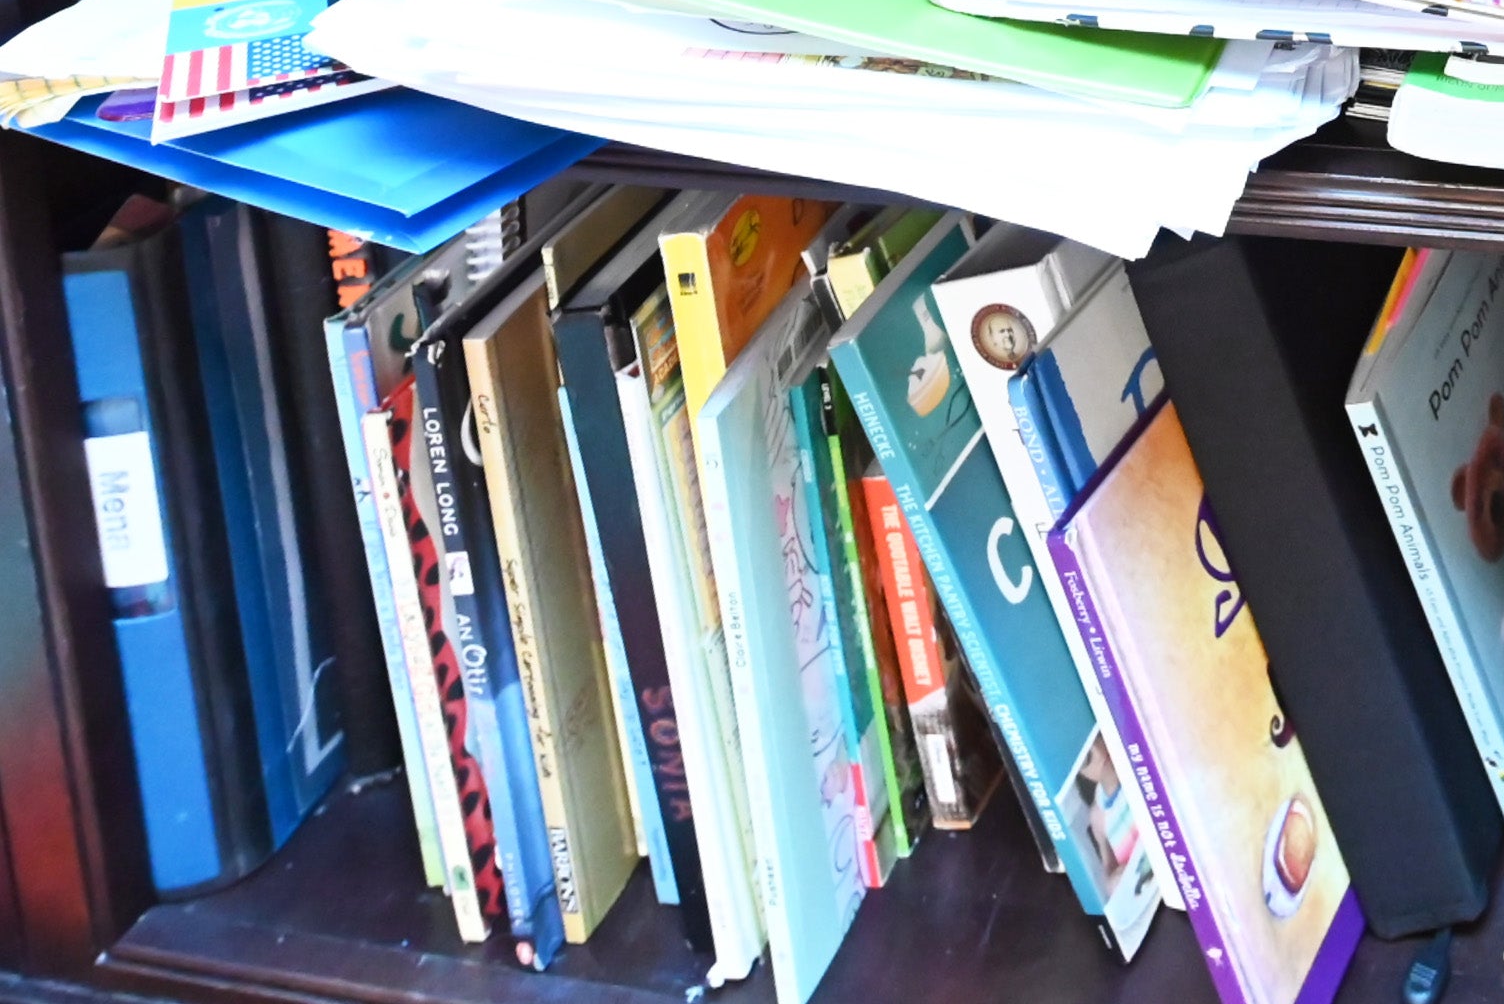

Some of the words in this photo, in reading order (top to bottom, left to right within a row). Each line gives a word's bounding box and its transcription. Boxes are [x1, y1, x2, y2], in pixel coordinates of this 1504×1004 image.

[1428, 360, 1464, 421] Pom
[1459, 305, 1491, 358] Pom
[853, 390, 895, 462] HEINECKE
[1011, 404, 1046, 464] BOND
[422, 406, 448, 475] LOREN
[436, 482, 459, 537] LONG
[97, 470, 131, 552] Mena
[879, 503, 902, 530] THE
[1371, 446, 1391, 490] Pom
[1386, 483, 1407, 518] Pom
[1400, 523, 1430, 581] Animals
[884, 531, 915, 600] QUOTABLE
[1057, 568, 1097, 627] Fosberry
[455, 613, 473, 640] AN
[898, 599, 924, 637] WALT
[460, 643, 488, 696] Otis
[895, 483, 918, 513] THE
[908, 512, 945, 574] KITCHEN
[935, 573, 971, 631] PANTRY
[992, 702, 1040, 781] CHEMISTRY
[1028, 778, 1052, 809] FOR
[1041, 807, 1067, 843] KIDS
[904, 635, 935, 688] DISNEY
